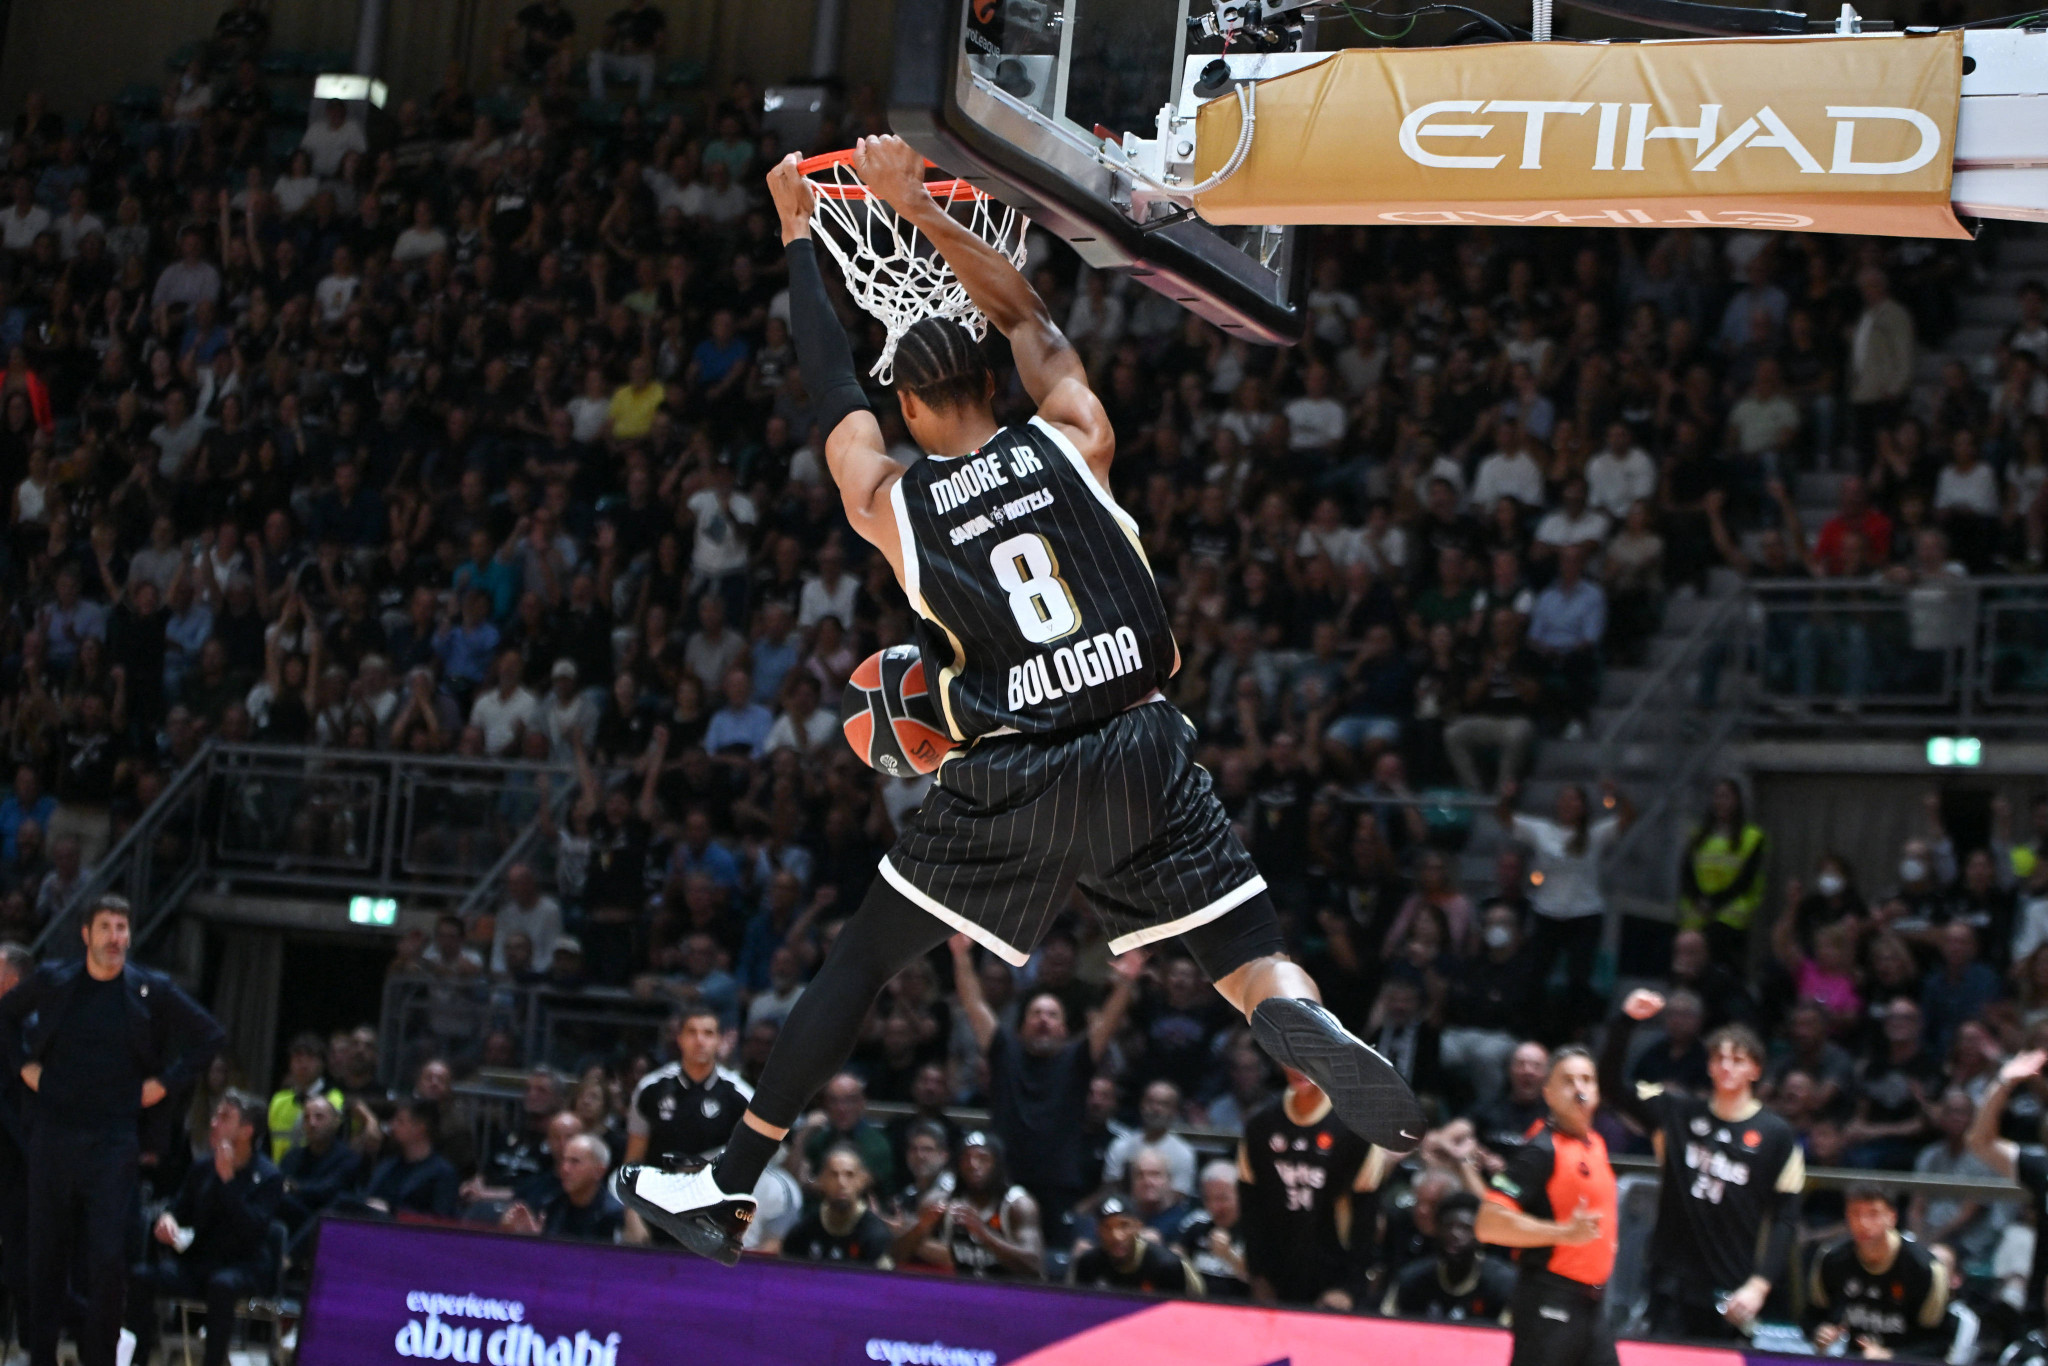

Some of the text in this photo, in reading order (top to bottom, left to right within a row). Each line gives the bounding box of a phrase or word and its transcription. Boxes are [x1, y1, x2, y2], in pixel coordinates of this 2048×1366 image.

[1399, 100, 1941, 175] ETIHAD
[1377, 209, 1814, 228] ETIHAD
[929, 445, 1044, 516] MOORE JR
[1002, 487, 1055, 521] HOTELS
[990, 533, 1082, 644] 8
[1007, 625, 1143, 712] BOLOGNA
[406, 1290, 525, 1323] experience
[395, 1315, 622, 1366] abu dhabi
